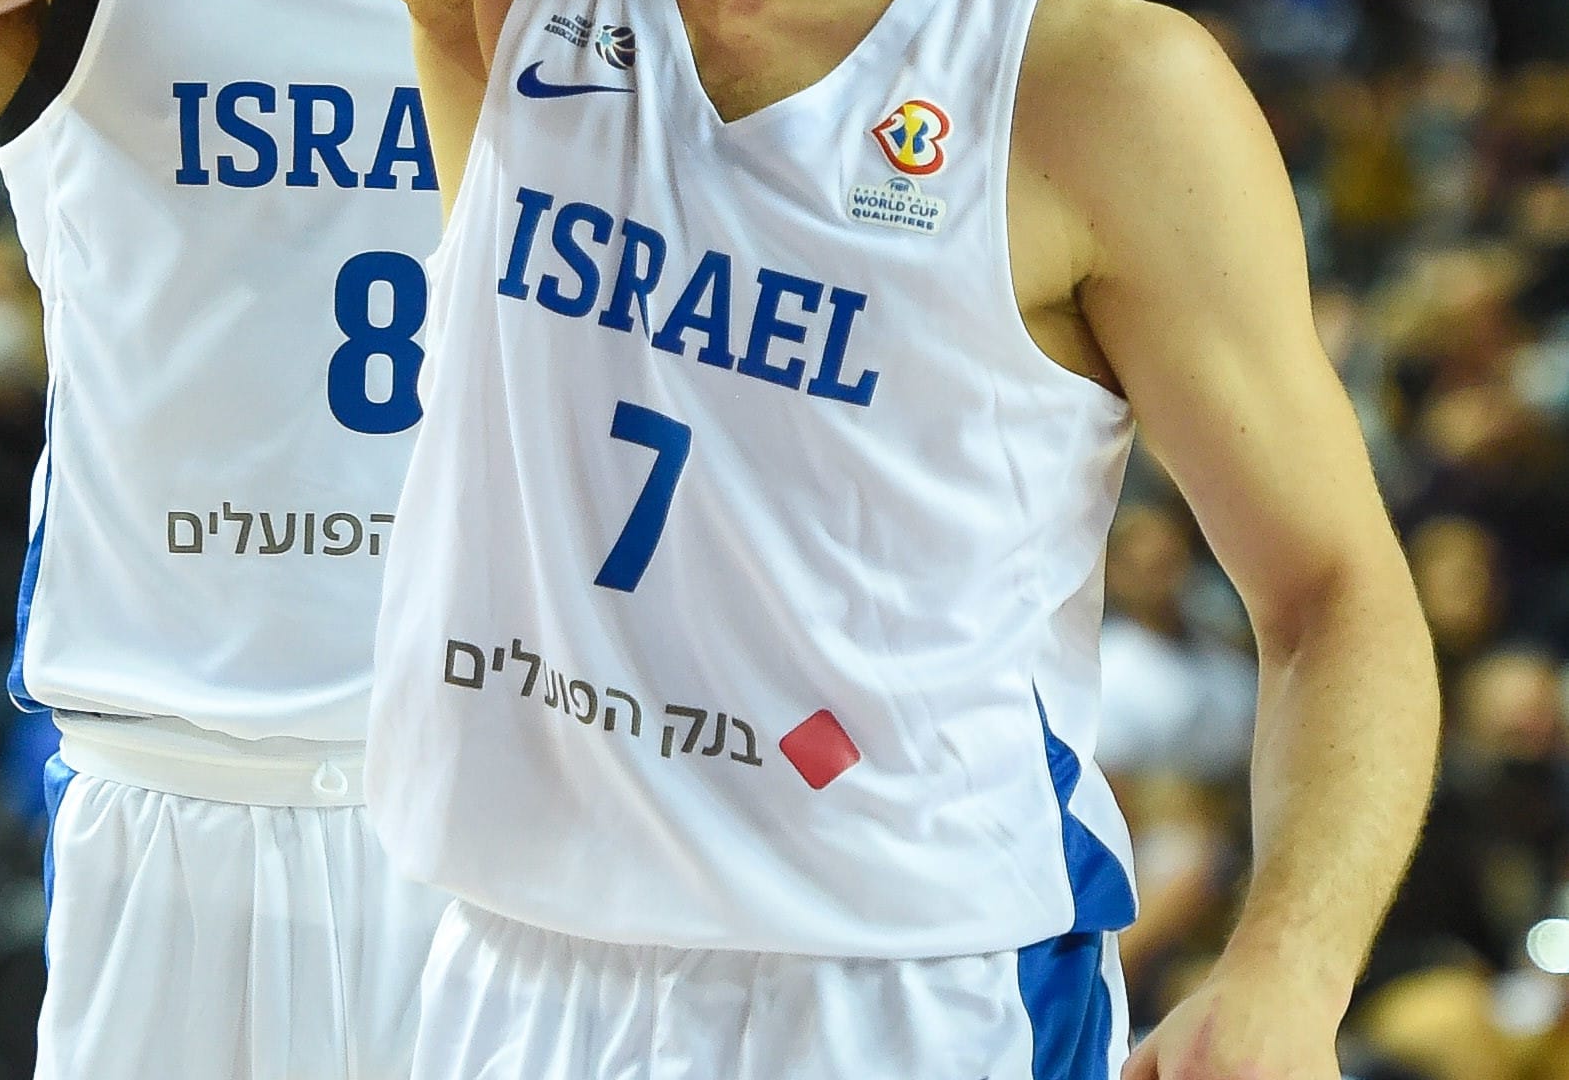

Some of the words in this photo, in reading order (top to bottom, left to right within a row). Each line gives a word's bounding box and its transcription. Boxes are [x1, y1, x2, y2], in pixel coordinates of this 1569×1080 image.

[852, 207, 935, 230] QUALIFIERS
[853, 193, 905, 212] WORLD
[909, 203, 939, 218] CUP
[328, 250, 427, 435] 8
[498, 186, 879, 407] ISRAEL
[593, 400, 692, 593] 7
[660, 704, 763, 767] בנק
